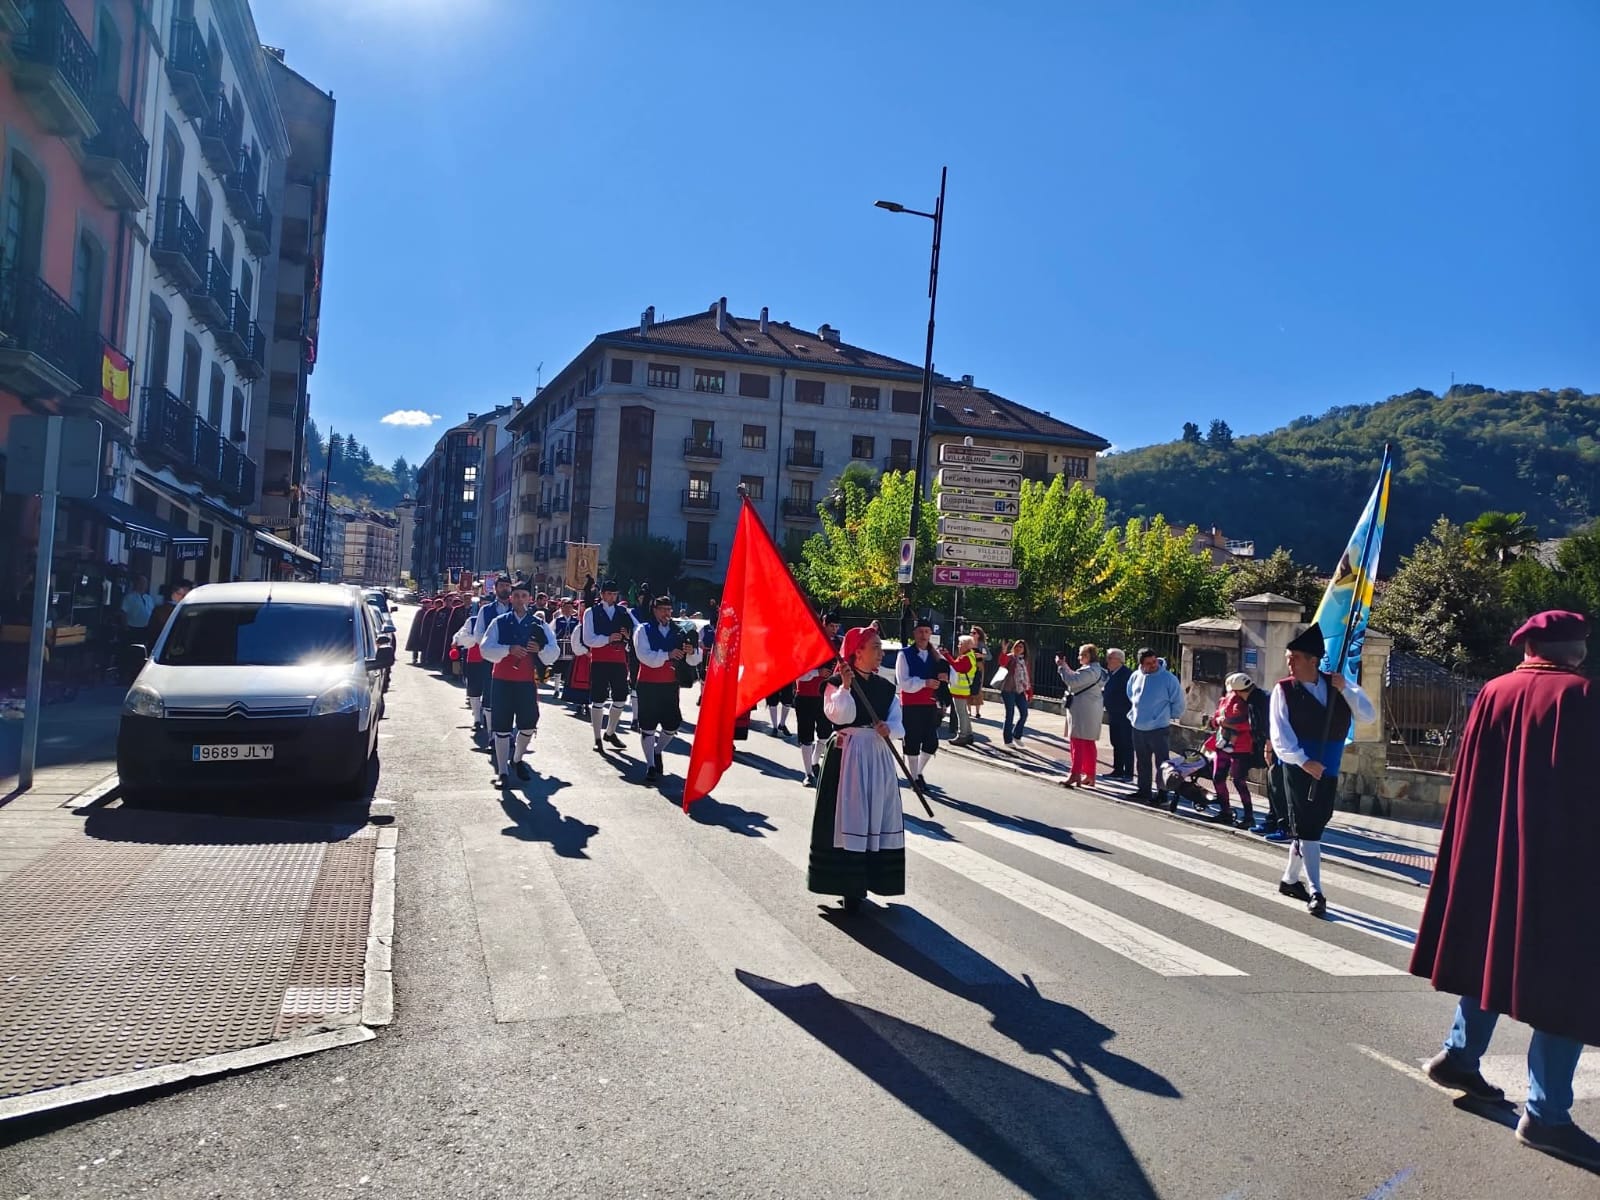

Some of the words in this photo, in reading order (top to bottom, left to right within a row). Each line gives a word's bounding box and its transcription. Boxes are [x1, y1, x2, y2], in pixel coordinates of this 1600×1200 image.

[933, 624, 940, 633] P
[202, 746, 239, 759] 9689
[244, 745, 270, 758] JLY
